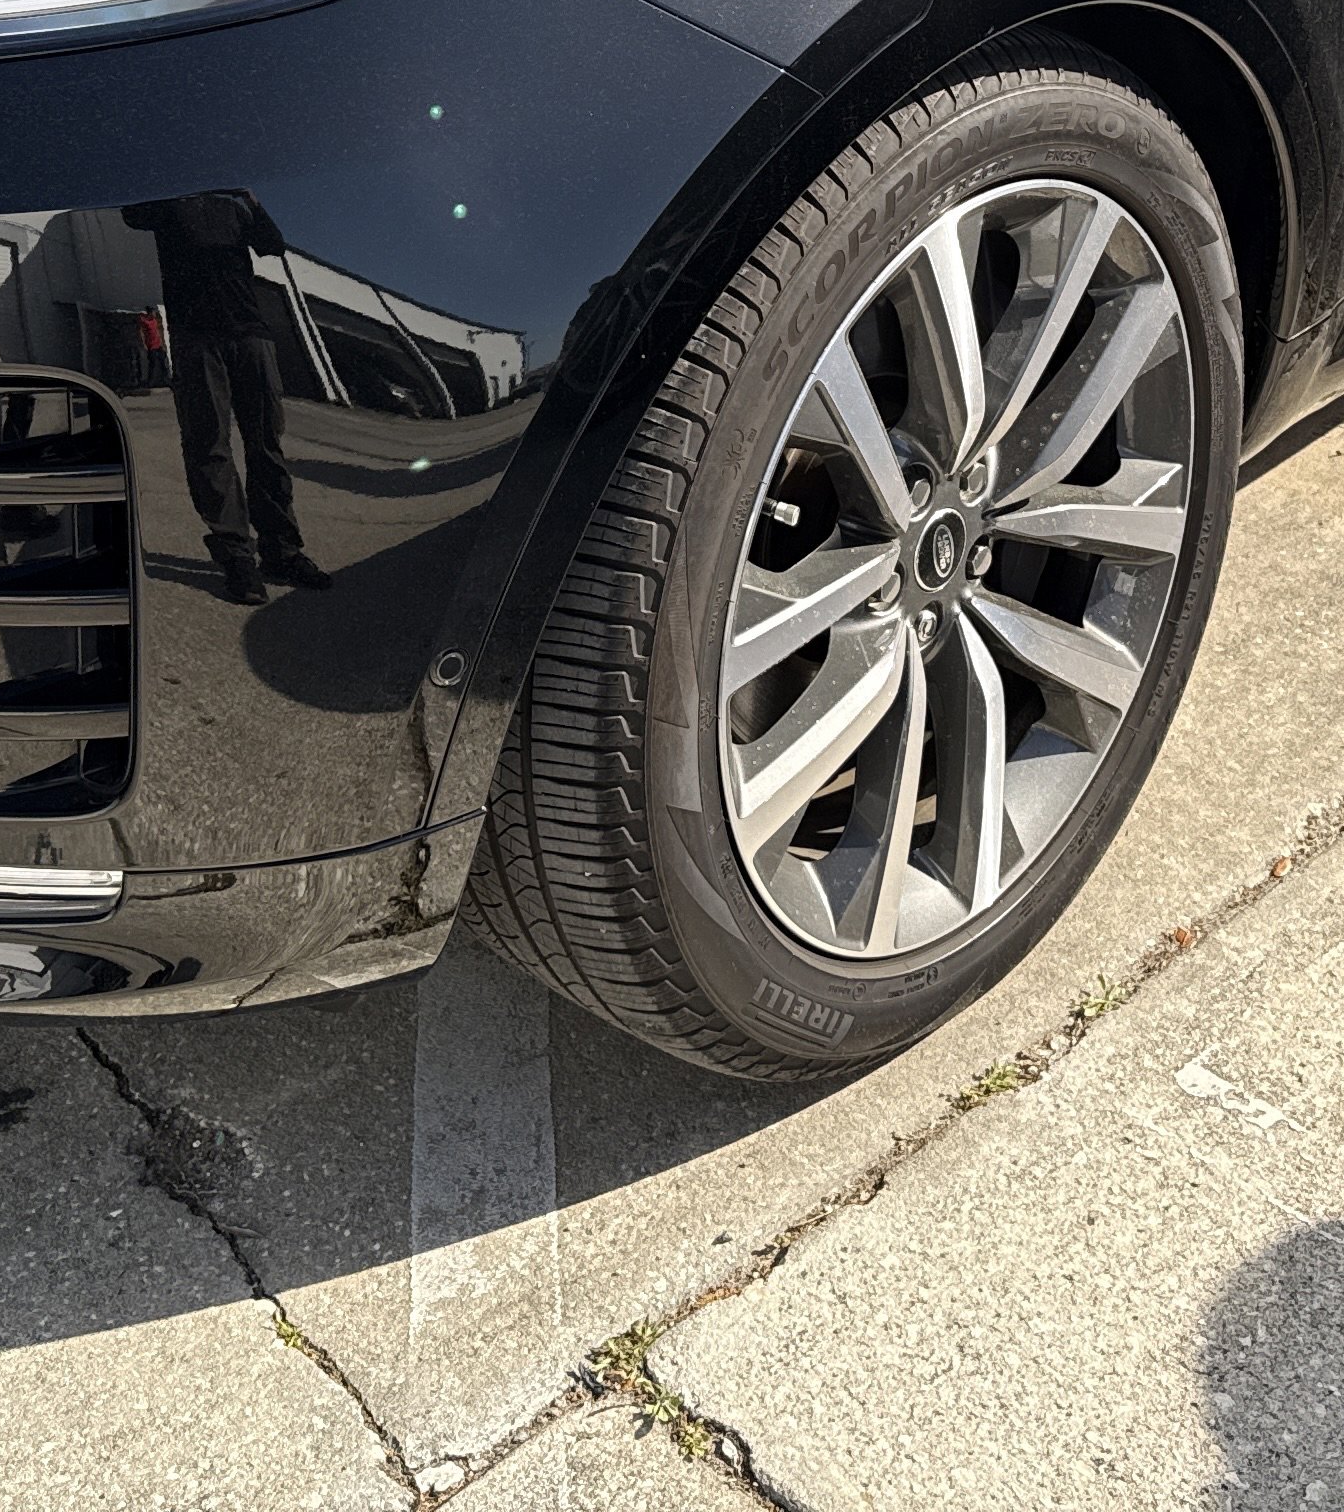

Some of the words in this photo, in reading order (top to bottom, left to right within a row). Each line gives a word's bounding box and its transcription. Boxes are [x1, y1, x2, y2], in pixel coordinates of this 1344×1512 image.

[762, 114, 995, 383] SCORPION
[1010, 100, 1129, 140] ZERO
[752, 977, 855, 1050] PIRELLI
